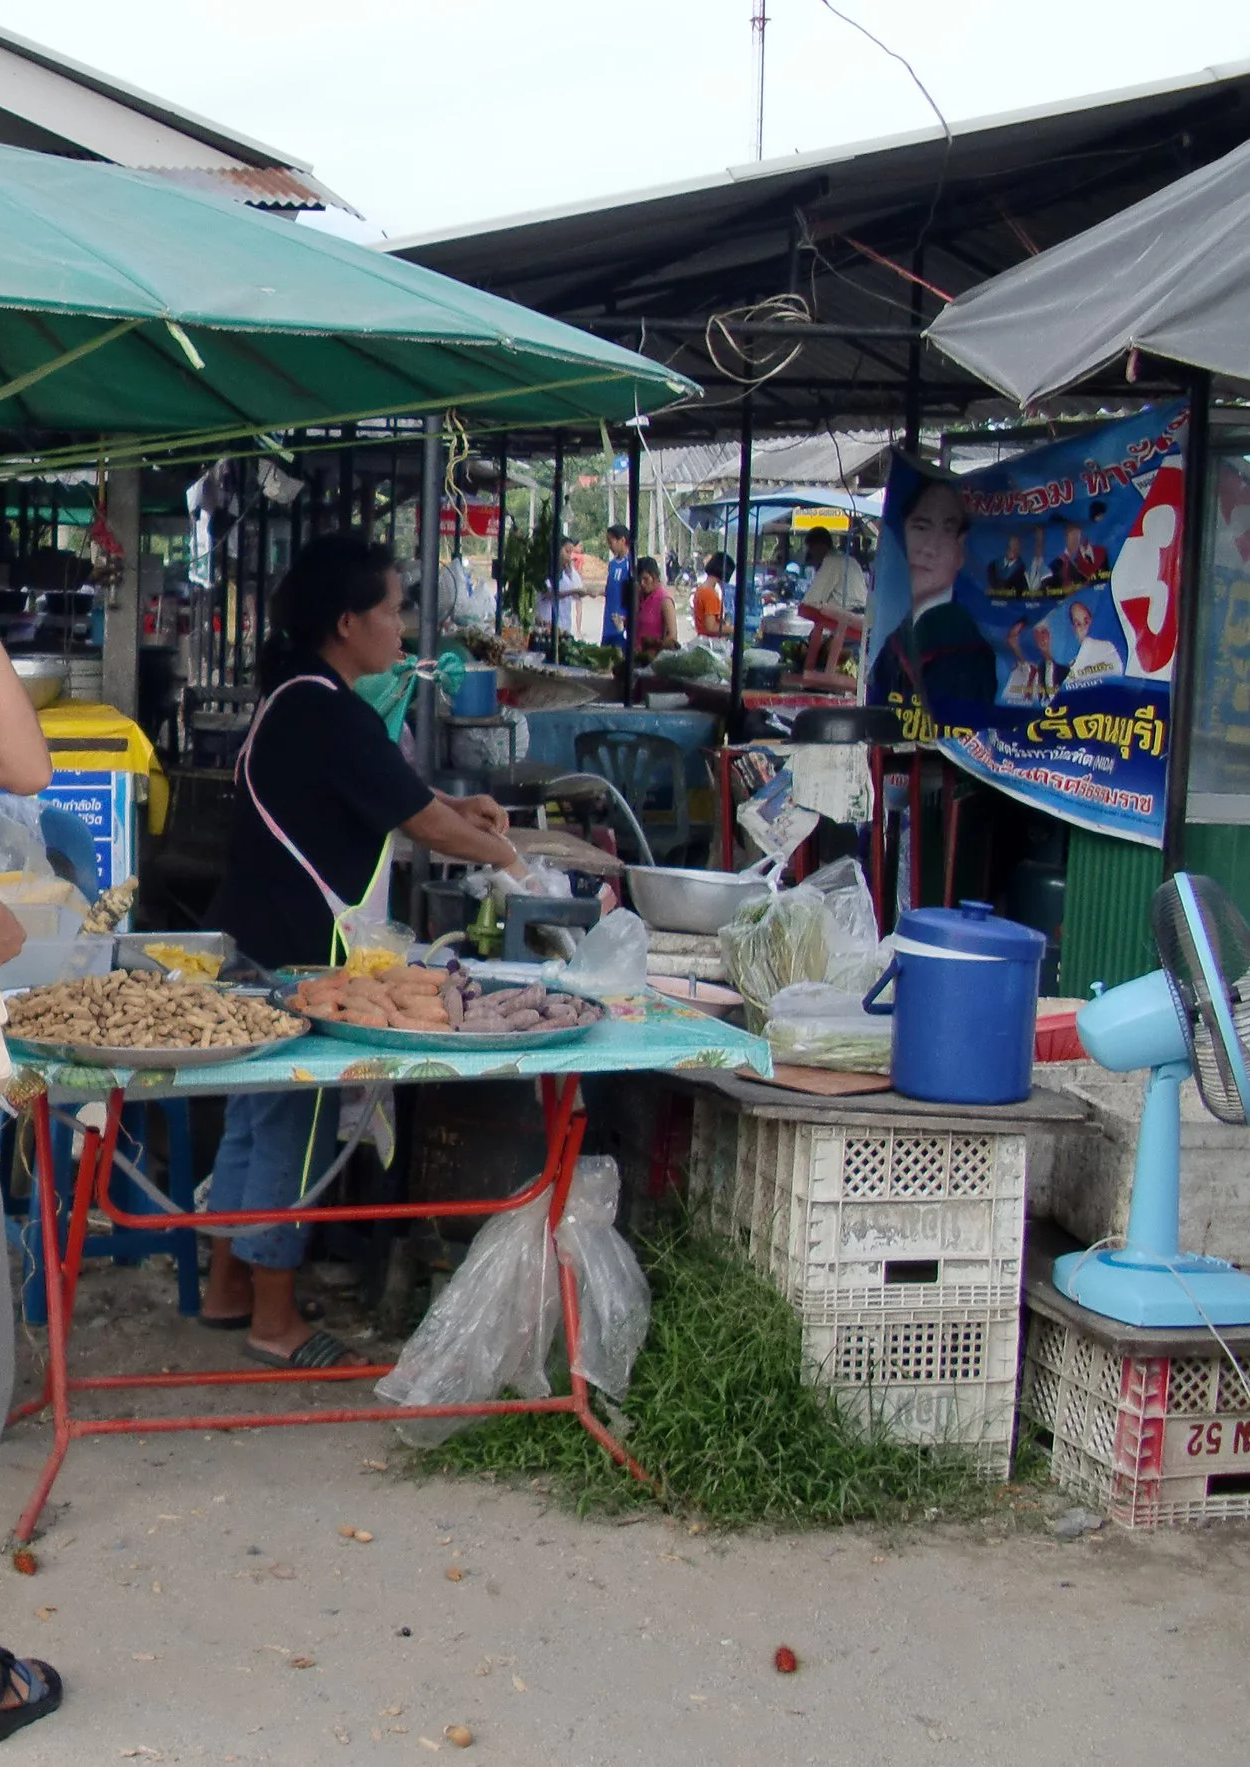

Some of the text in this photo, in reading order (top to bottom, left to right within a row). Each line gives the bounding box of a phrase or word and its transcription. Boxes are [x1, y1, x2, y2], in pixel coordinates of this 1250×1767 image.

[1027, 705, 1164, 759] (รัตนบุรี)
[1187, 1422, 1223, 1456] 52
